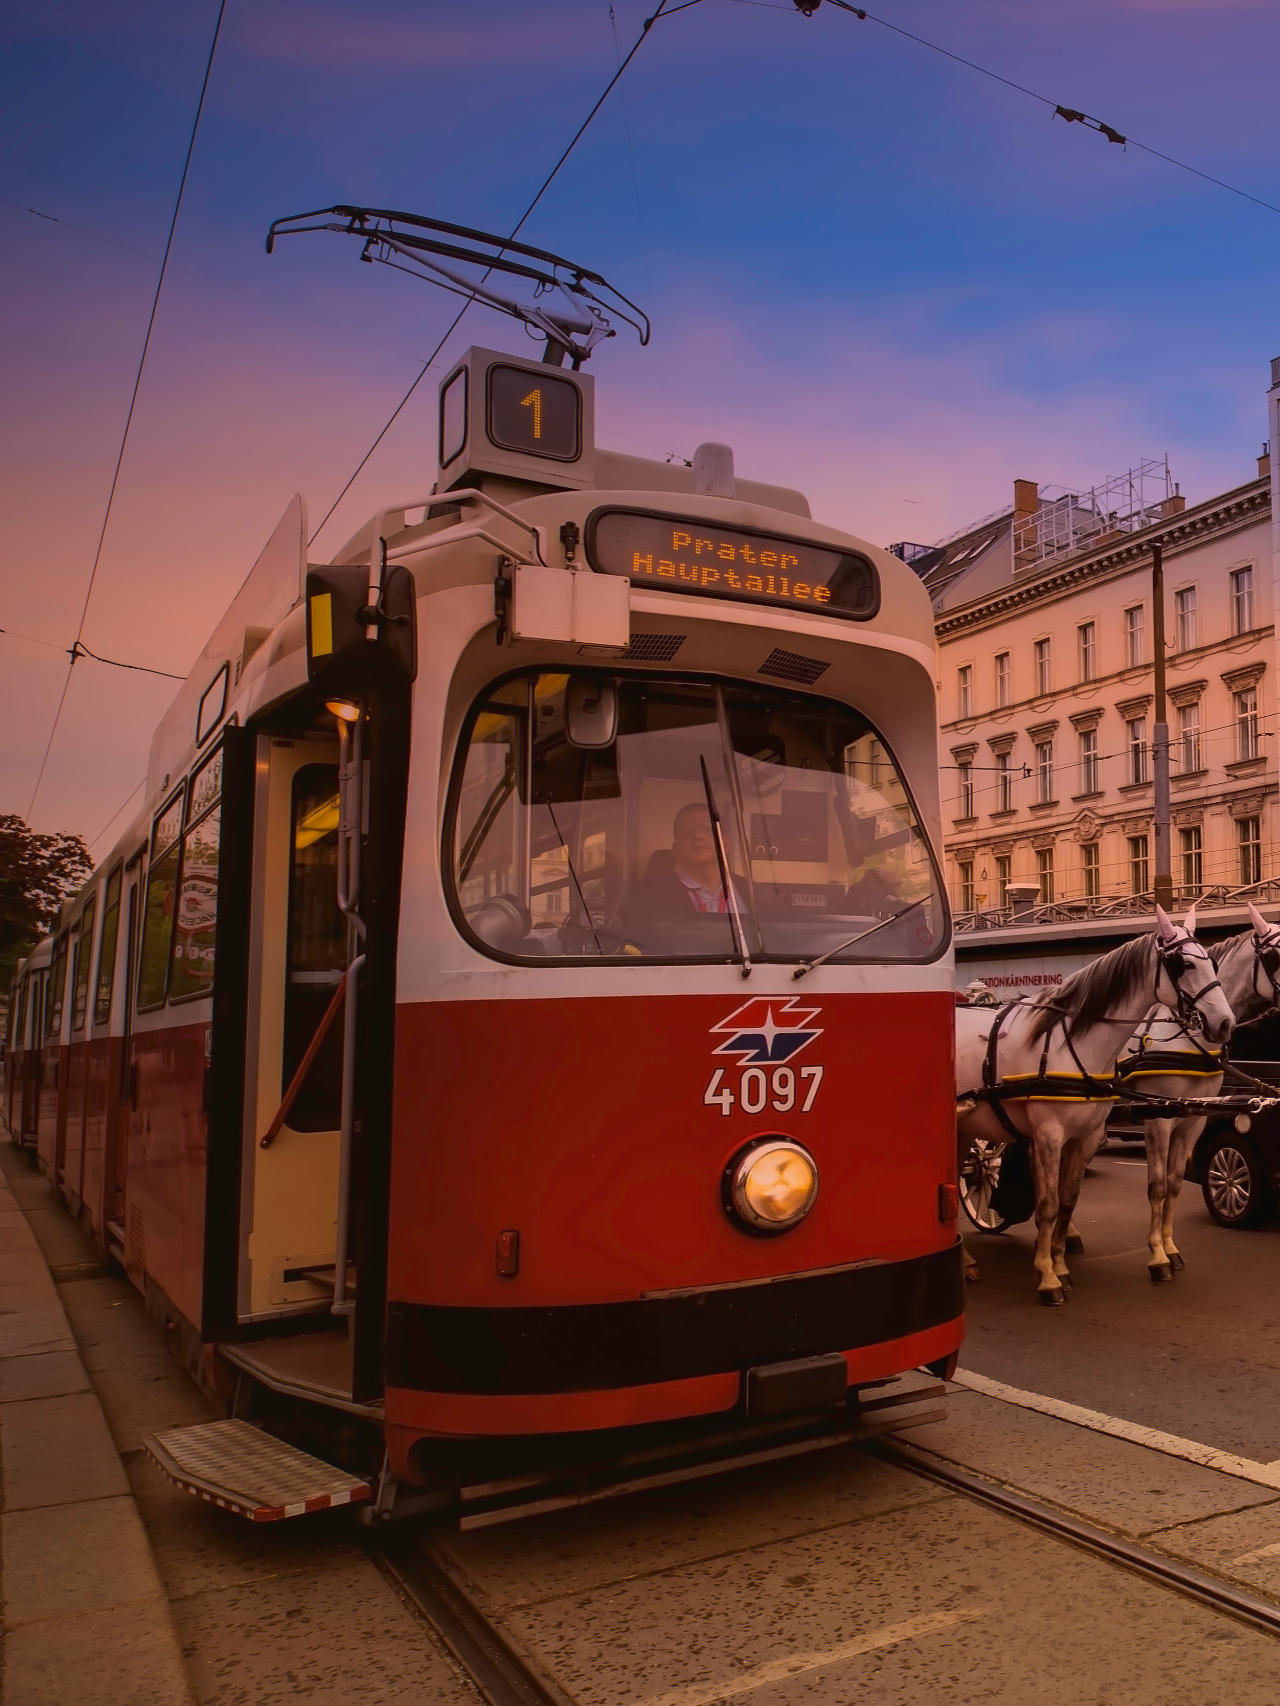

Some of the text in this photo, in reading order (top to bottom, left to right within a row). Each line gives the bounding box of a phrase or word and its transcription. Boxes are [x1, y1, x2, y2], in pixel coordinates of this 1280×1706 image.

[520, 389, 541, 439] 1
[672, 530, 799, 569] Prater
[632, 551, 831, 603] Hauptallee
[1005, 973, 1042, 987] KÄRNTNER
[1043, 974, 1063, 985] RING
[703, 1065, 825, 1116] 4097
